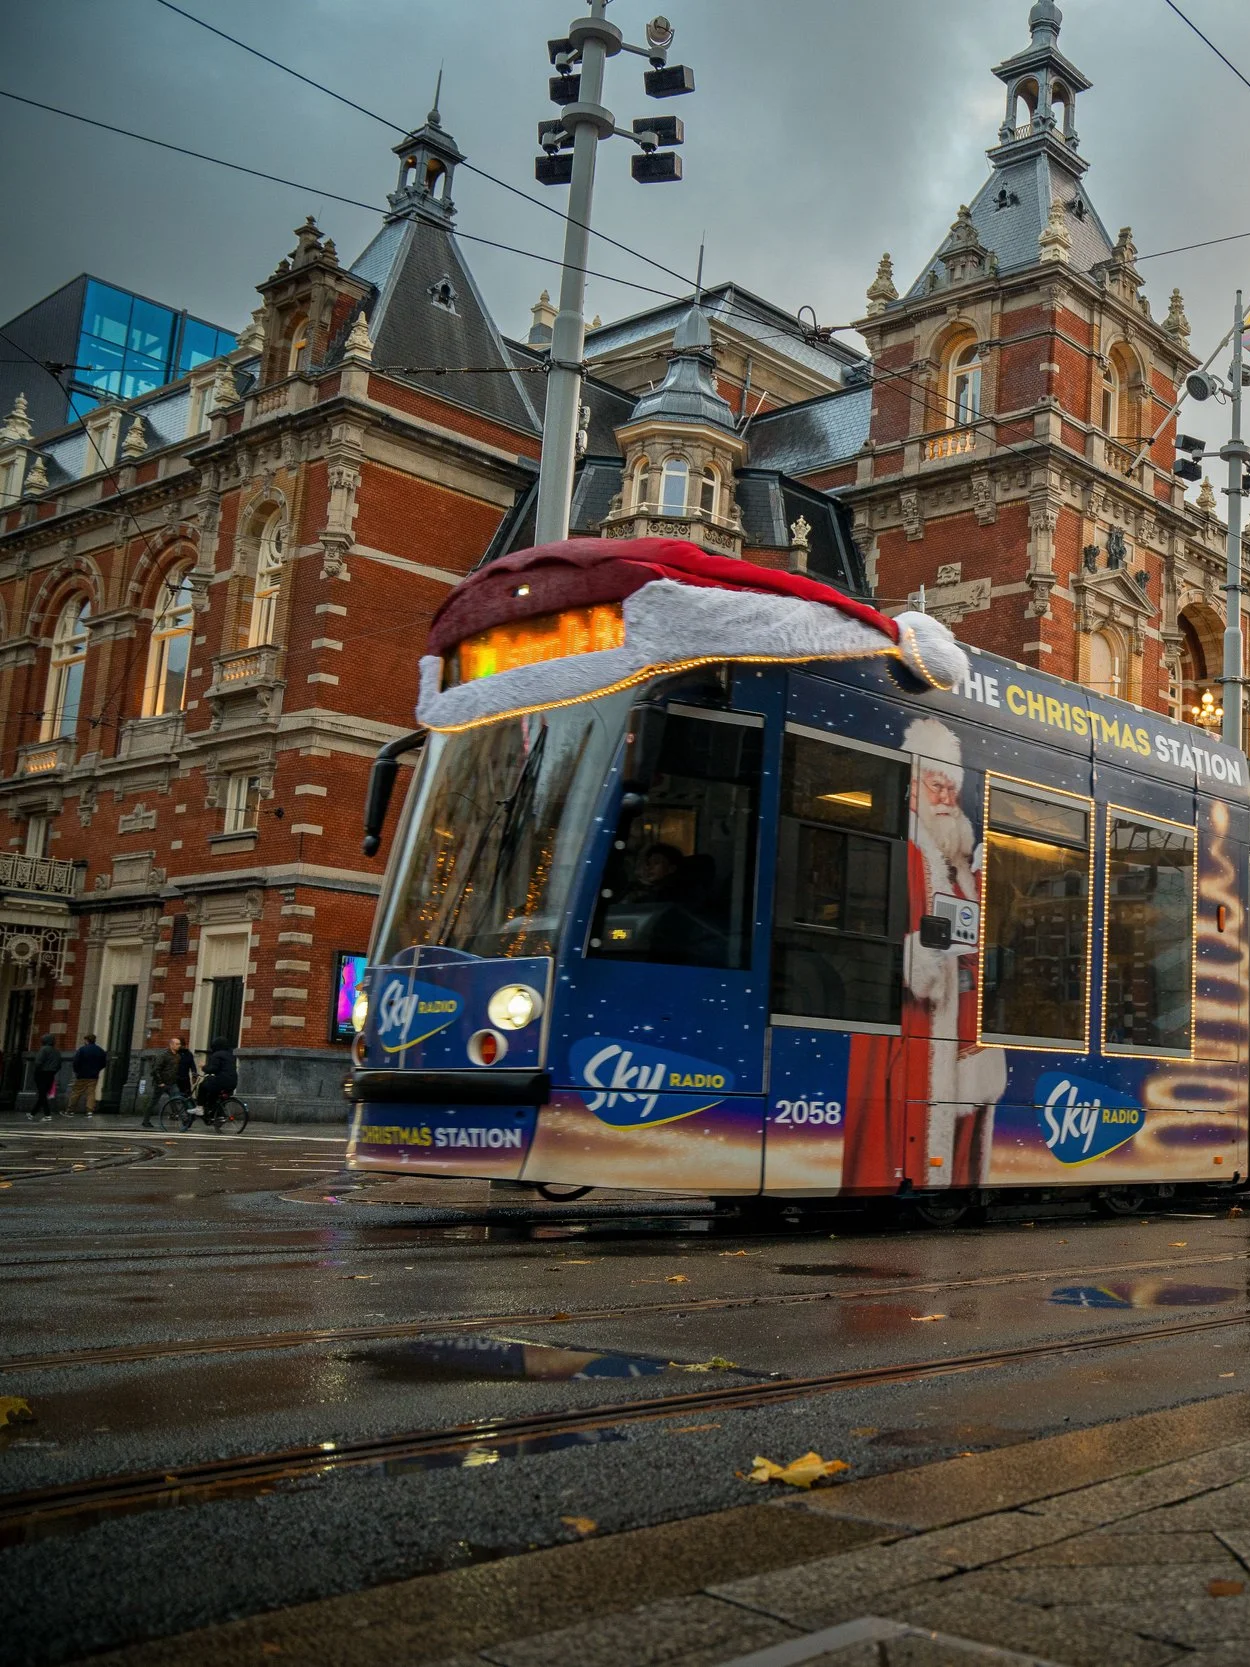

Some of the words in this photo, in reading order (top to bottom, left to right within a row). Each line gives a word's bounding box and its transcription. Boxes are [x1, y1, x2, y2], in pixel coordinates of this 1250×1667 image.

[1006, 685, 1151, 756] CHRISTMAS
[1155, 735, 1241, 785] STATION
[378, 980, 419, 1039] Sky
[418, 1000, 457, 1013] RADIO
[583, 1044, 667, 1117] Sky
[669, 1073, 725, 1088] RADIO
[774, 1100, 842, 1125] 2058
[434, 1128, 522, 1148] STATION
[1044, 1079, 1100, 1153] Sky
[1102, 1108, 1139, 1124] RADIO
